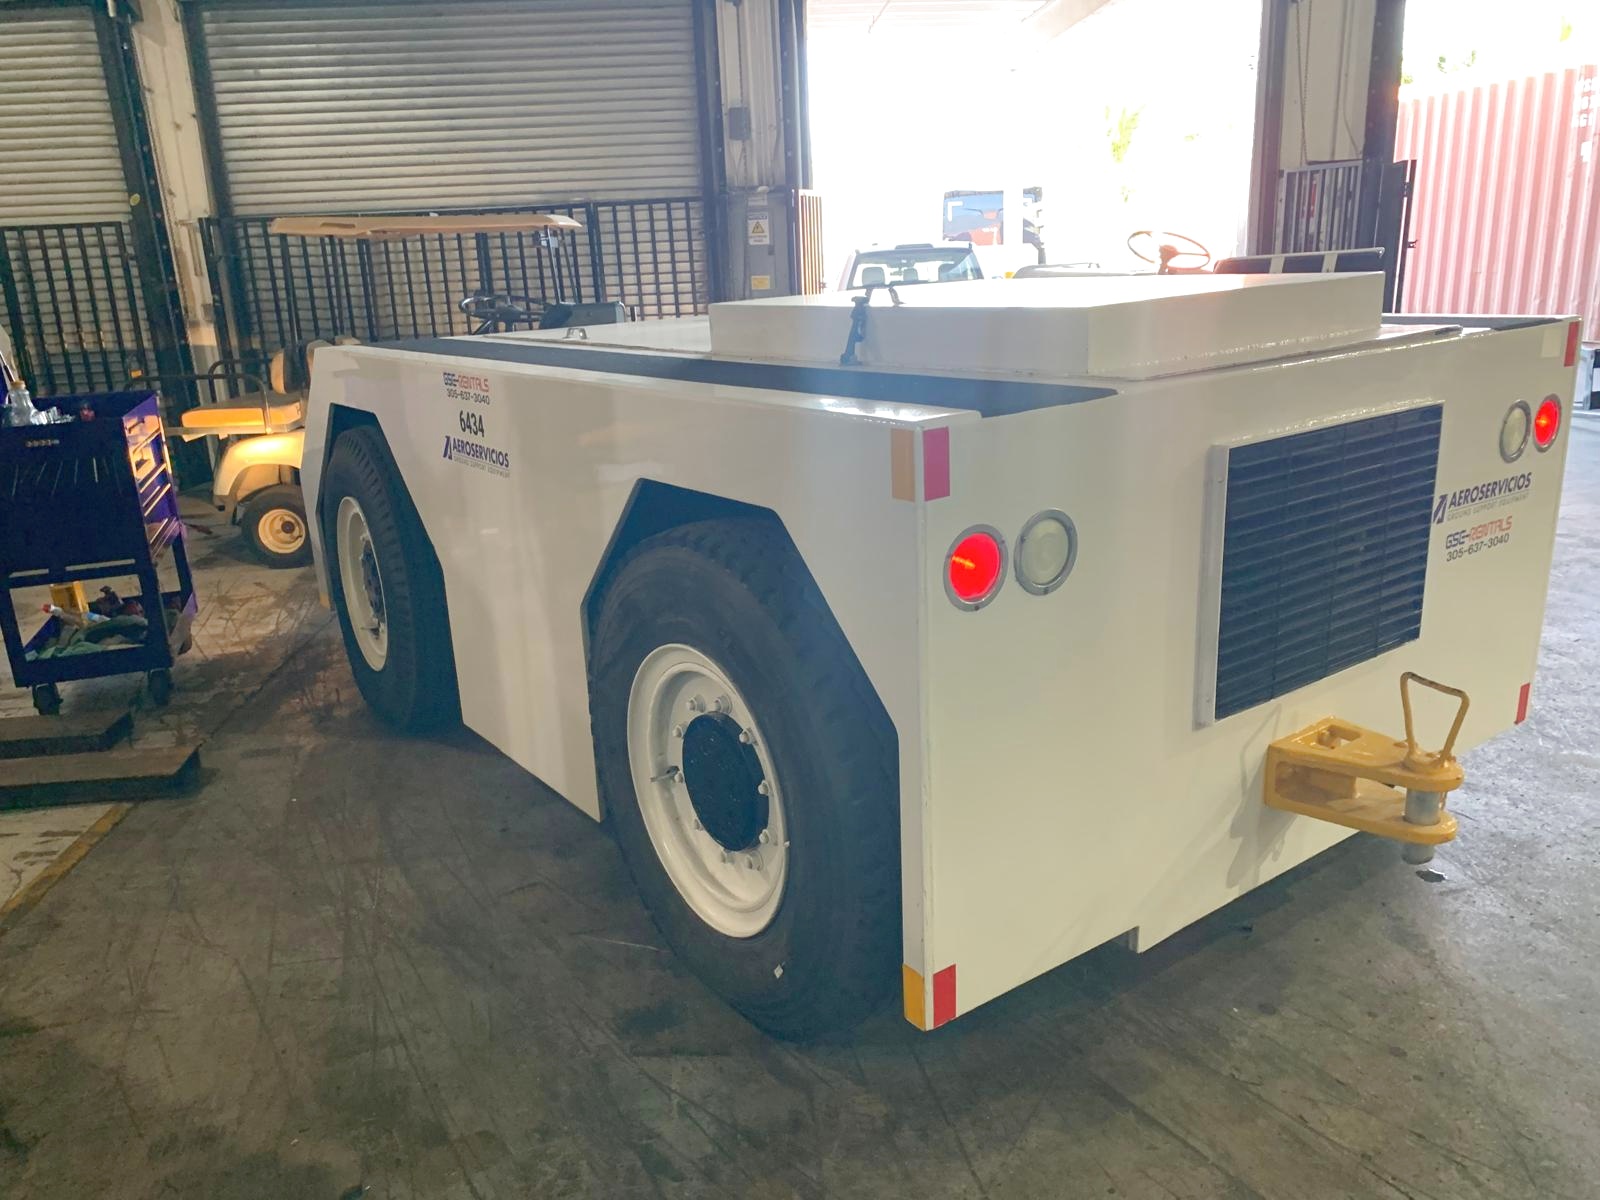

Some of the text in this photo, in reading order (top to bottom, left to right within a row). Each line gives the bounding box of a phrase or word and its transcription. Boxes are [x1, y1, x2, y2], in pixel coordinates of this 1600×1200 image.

[447, 388, 490, 405] 305-637-3040
[460, 410, 484, 438] 6434
[452, 438, 510, 468] AEROSERVICIOS
[1448, 472, 1532, 509] AEROSERVICIOS
[1446, 533, 1510, 562] 305-637-3040
